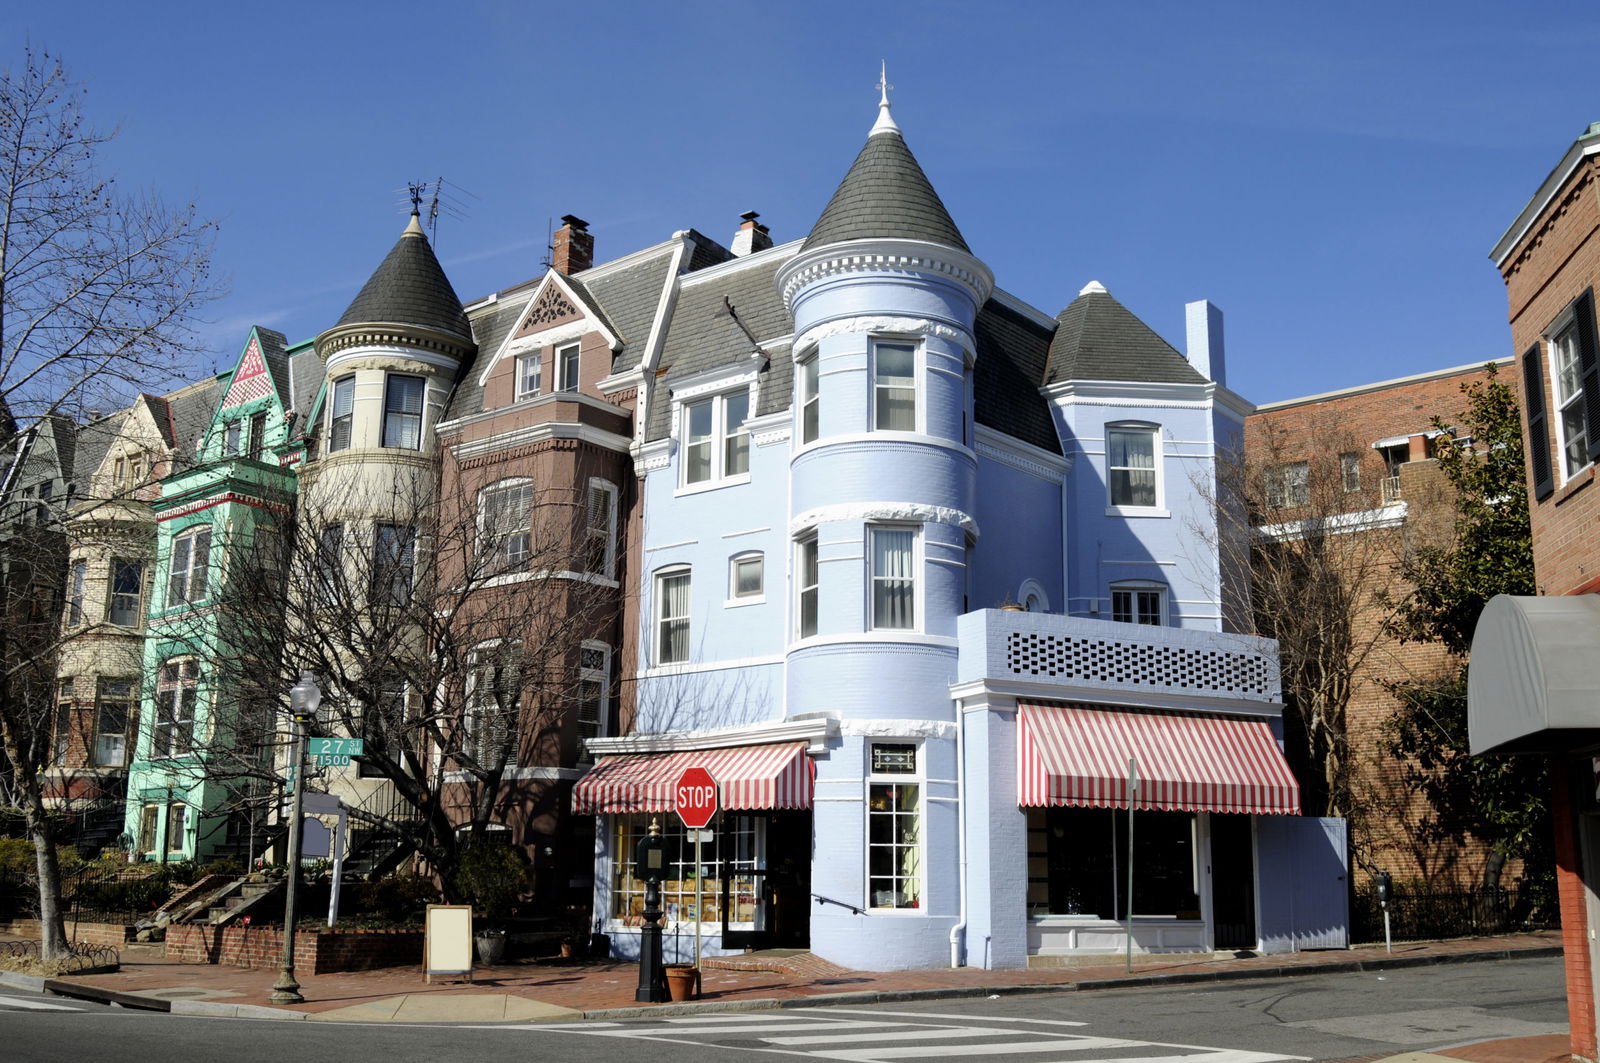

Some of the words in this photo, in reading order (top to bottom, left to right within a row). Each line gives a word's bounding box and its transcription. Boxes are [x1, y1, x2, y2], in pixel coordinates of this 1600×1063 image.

[321, 739, 344, 754] 27
[349, 740, 360, 748] ST
[348, 747, 361, 755] NW
[319, 755, 349, 766] 1500
[678, 785, 714, 809] STOP
